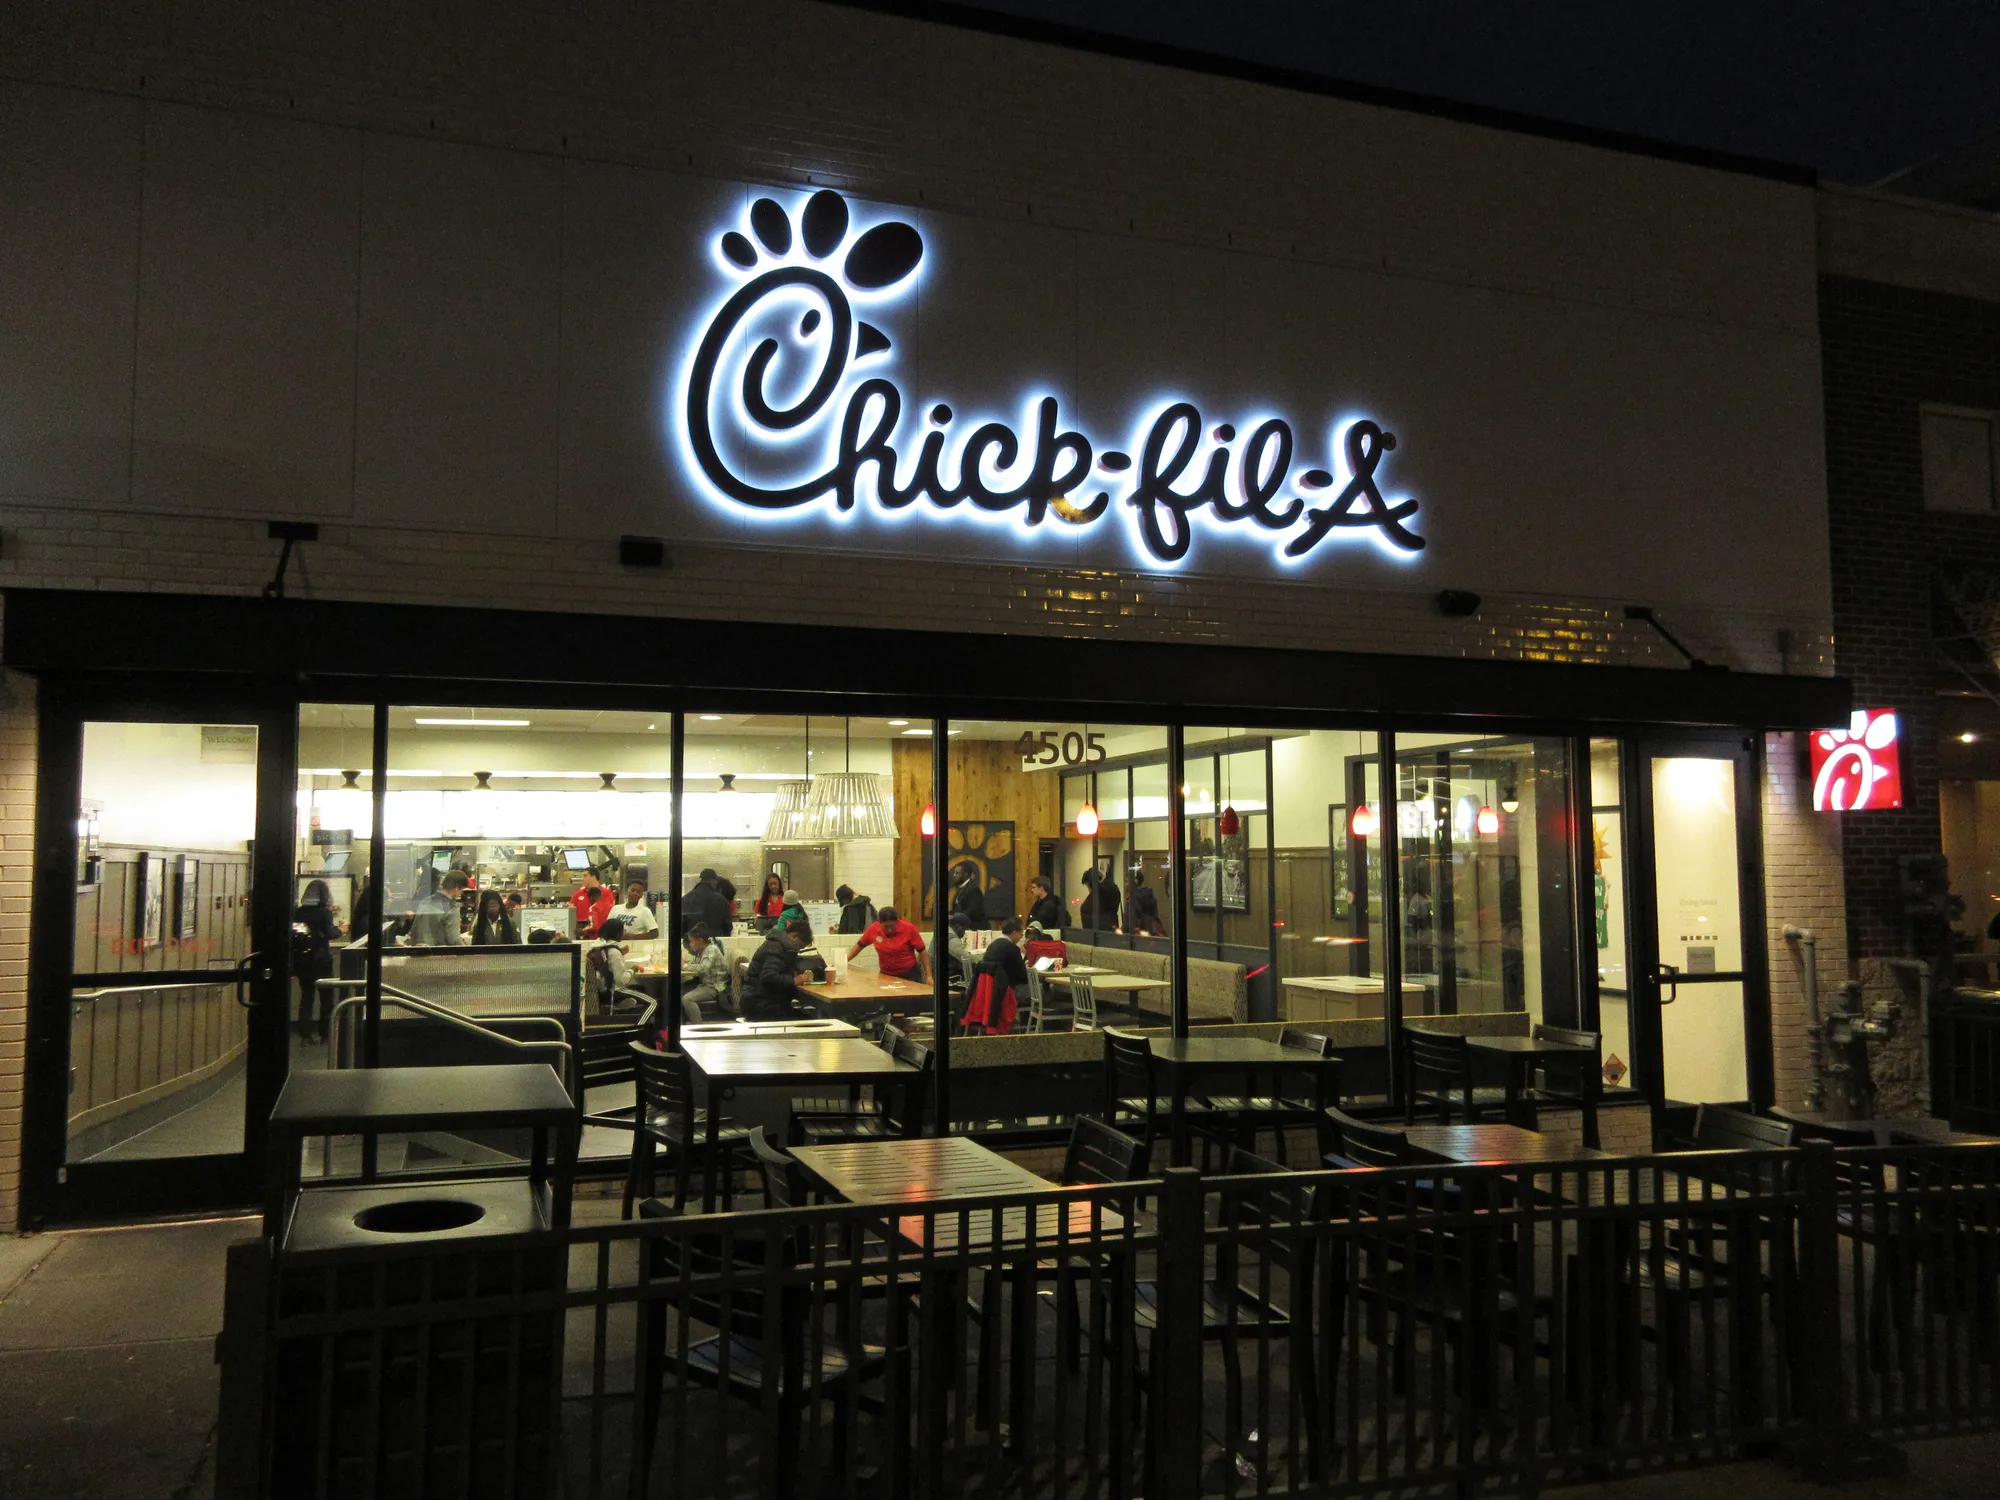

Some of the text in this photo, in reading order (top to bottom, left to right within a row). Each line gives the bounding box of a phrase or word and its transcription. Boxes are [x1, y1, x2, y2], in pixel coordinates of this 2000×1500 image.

[687, 189, 1425, 561] Chick-fil-A
[1014, 731, 1107, 765] 4505
[111, 938, 157, 955] EXIT
